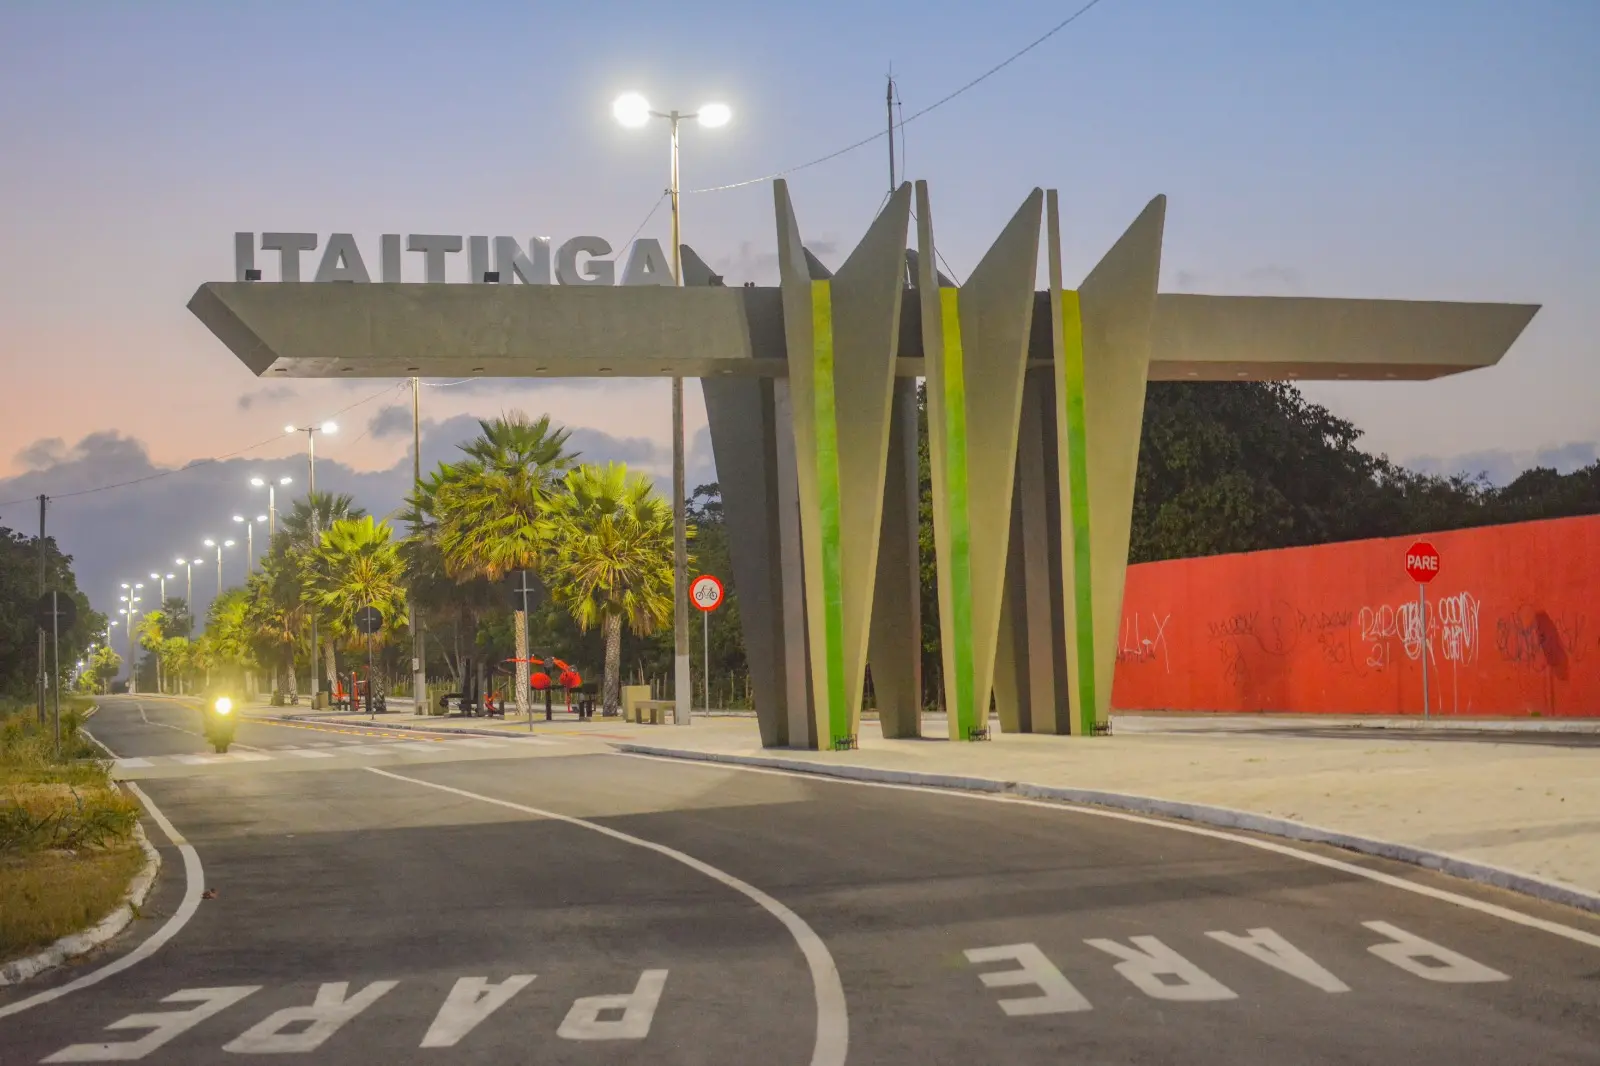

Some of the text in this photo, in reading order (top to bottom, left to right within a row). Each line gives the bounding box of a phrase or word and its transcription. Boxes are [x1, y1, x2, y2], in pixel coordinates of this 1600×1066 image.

[235, 231, 677, 286] ITAITINGA
[1407, 554, 1438, 571] PARE
[963, 920, 1511, 1016] PARE
[39, 969, 669, 1063] PARE
